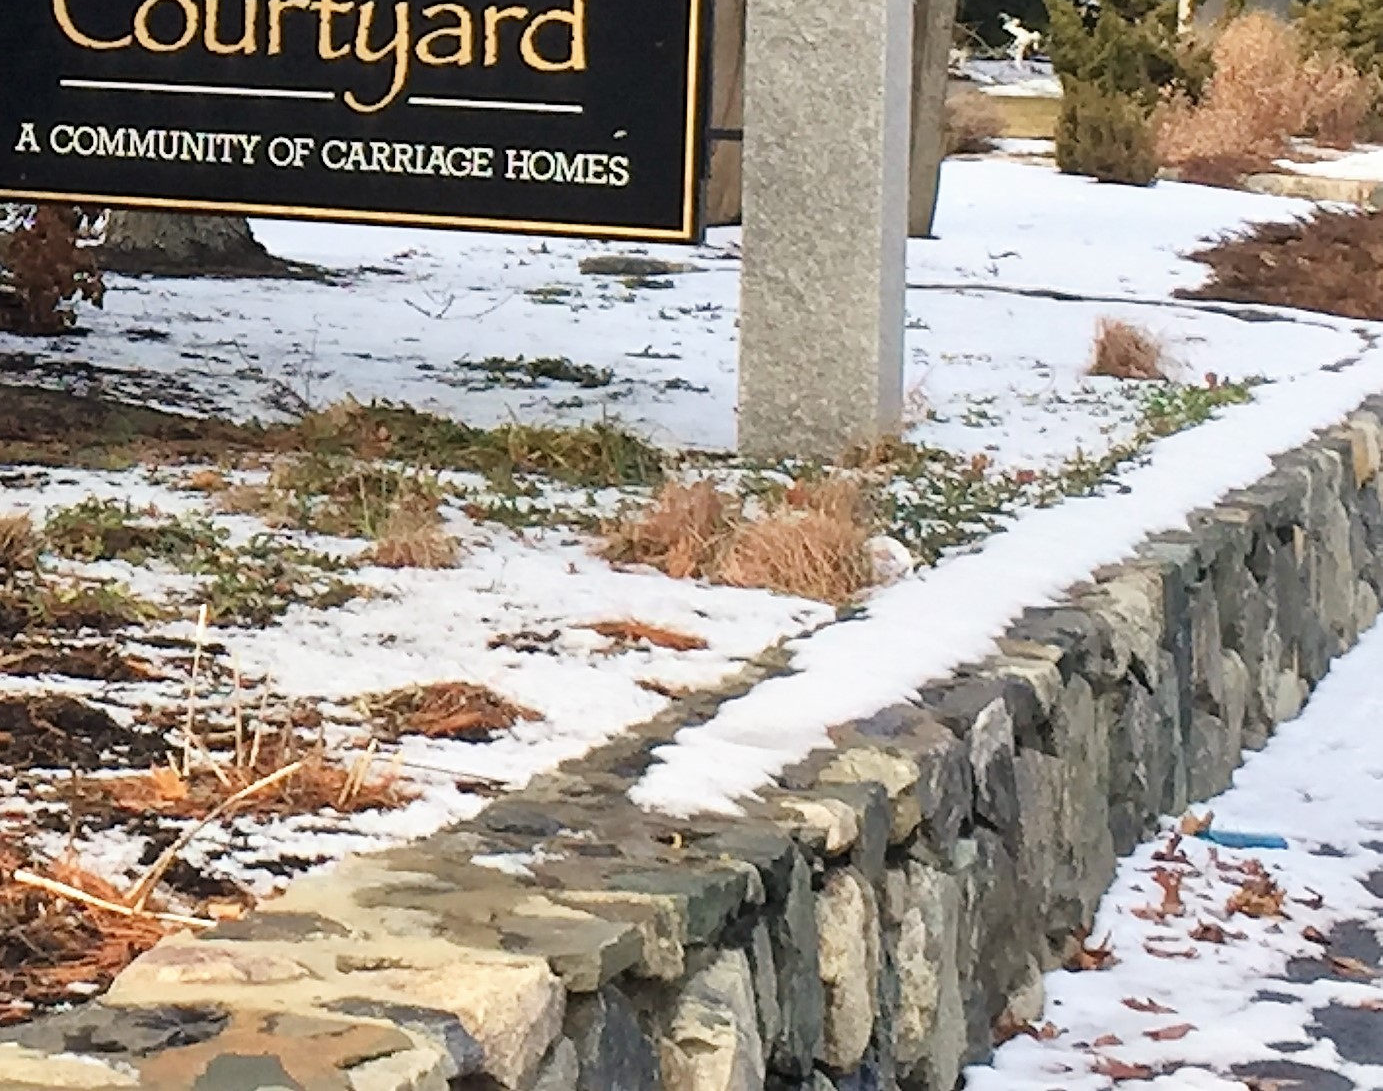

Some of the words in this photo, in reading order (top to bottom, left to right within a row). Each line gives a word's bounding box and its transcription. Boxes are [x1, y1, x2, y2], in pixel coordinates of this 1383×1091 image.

[14, 122, 41, 153] A
[49, 124, 262, 165] COMMUNITY
[267, 136, 315, 168] OF
[321, 139, 494, 178] CARRIAGE
[504, 149, 630, 187] HOMES
